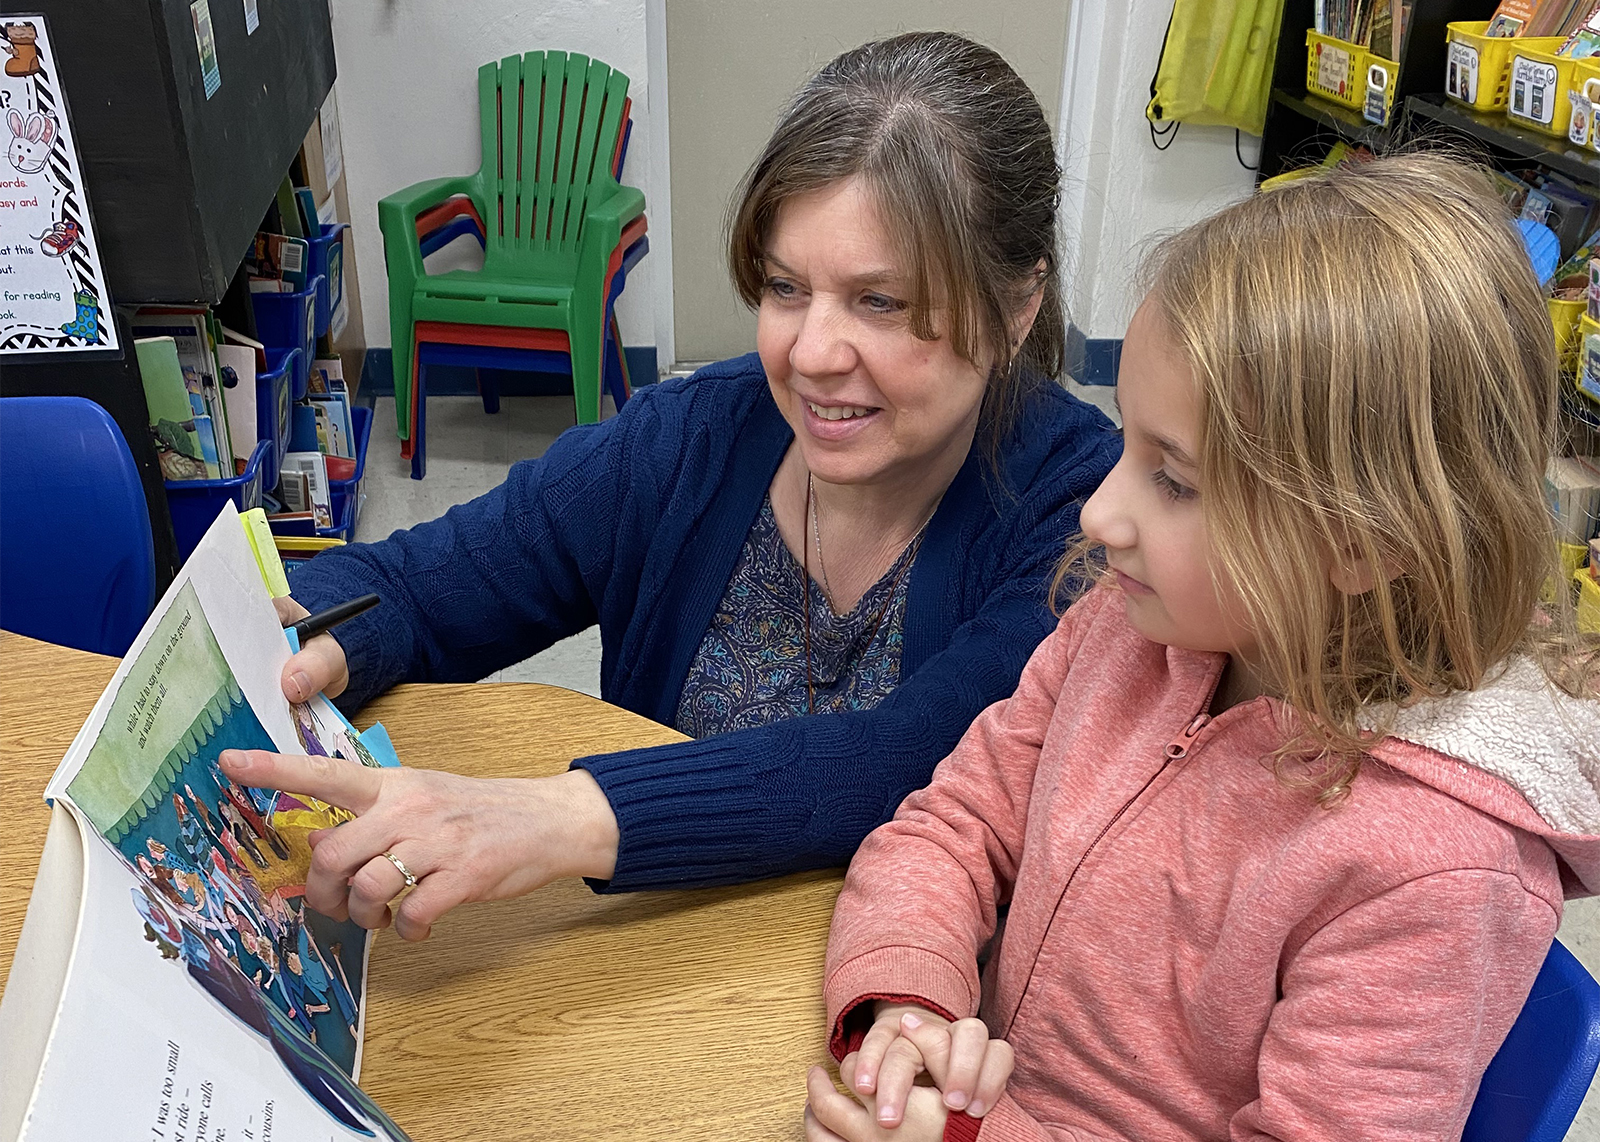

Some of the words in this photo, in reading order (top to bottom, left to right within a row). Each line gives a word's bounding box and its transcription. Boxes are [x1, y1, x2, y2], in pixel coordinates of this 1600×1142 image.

[20, 195, 38, 207] and
[0, 245, 11, 256] at
[15, 244, 34, 255] this
[4, 290, 20, 301] for
[23, 289, 61, 301] reading
[177, 609, 192, 639] ground
[170, 633, 179, 647] the
[165, 644, 173, 656] on
[154, 653, 167, 675] down
[148, 672, 158, 689] stay
[136, 691, 147, 710] had
[143, 686, 150, 697] to
[133, 704, 141, 715] I
[138, 730, 147, 749] and
[143, 712, 155, 734] watch
[150, 696, 163, 715] them
[159, 683, 168, 698] all.
[127, 713, 139, 733] while
[167, 1039, 180, 1075] small
[162, 1077, 174, 1098] too
[200, 1079, 214, 1109] calls
[157, 1100, 171, 1126] was
[174, 1102, 190, 1130] ride
[261, 1099, 275, 1142] cousins,
[151, 1127, 164, 1137] I
[241, 1128, 254, 1140] it
